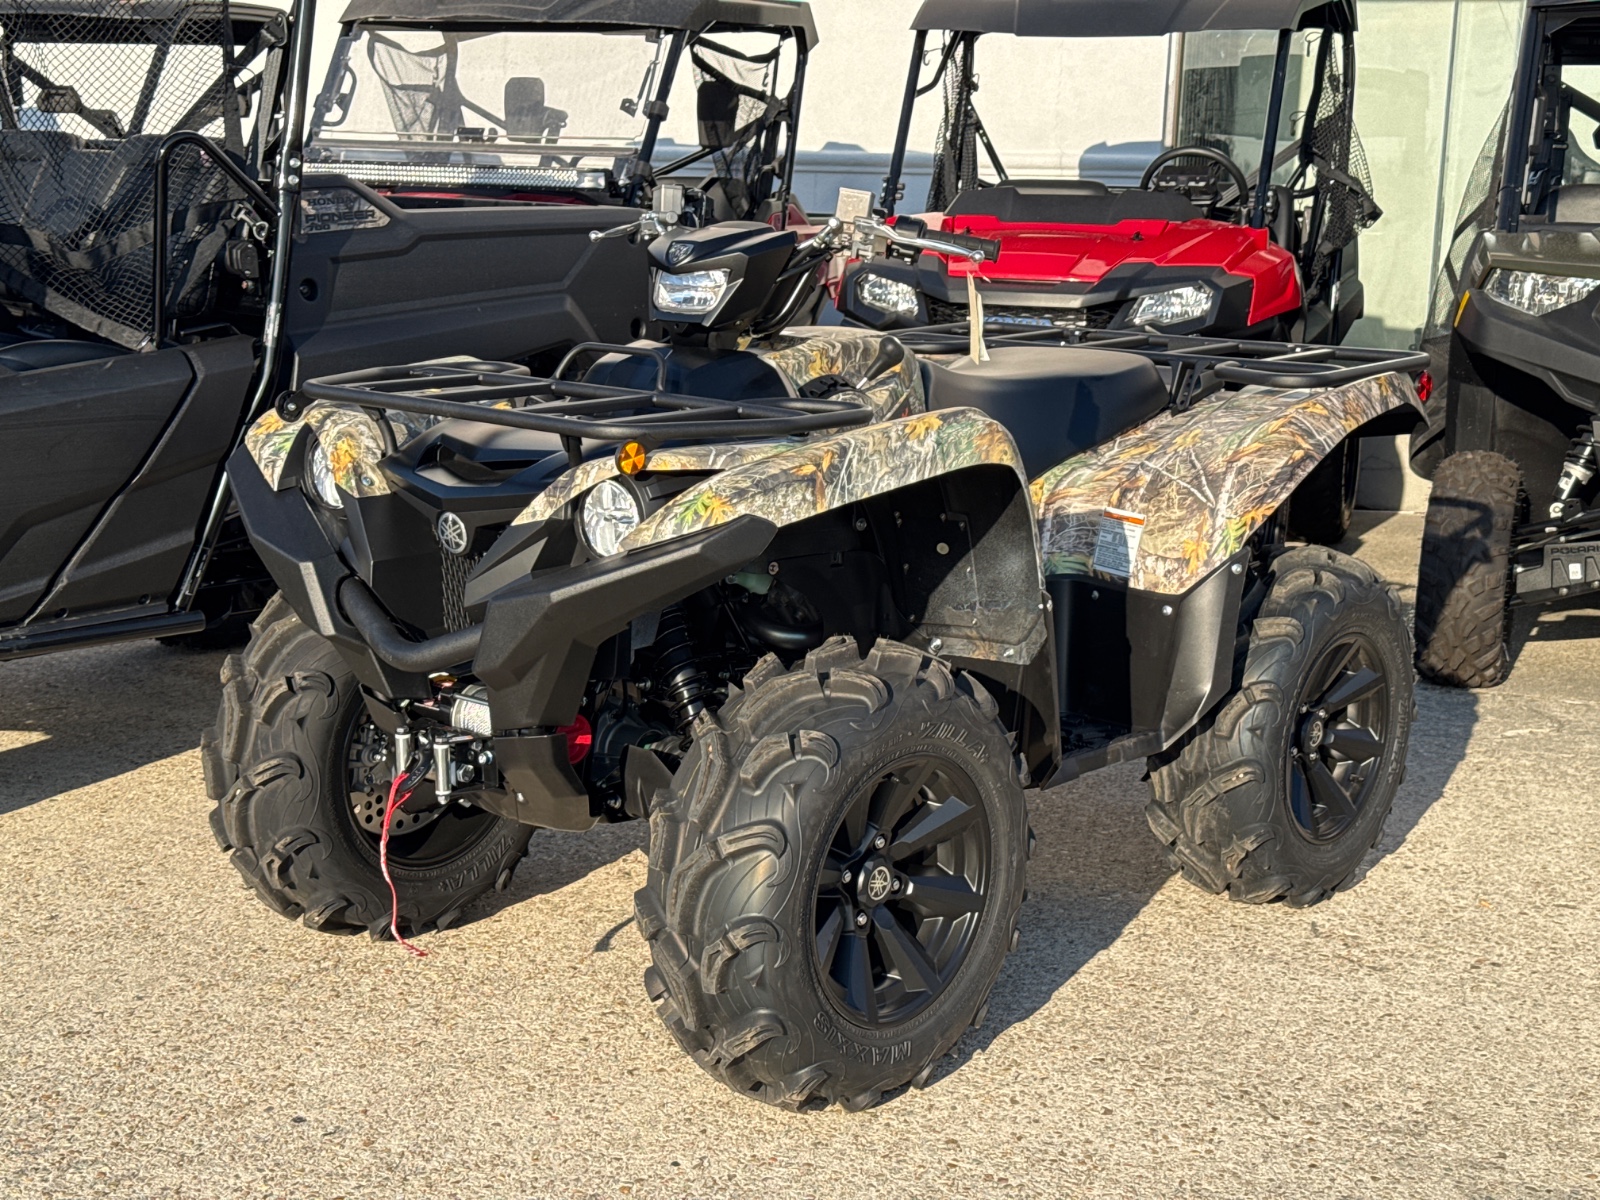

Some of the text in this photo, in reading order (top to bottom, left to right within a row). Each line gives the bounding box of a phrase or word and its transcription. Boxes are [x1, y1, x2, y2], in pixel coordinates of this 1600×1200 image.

[307, 196, 355, 206] HONDA
[305, 210, 376, 224] PIONEER
[813, 1011, 912, 1066] MAXXIS
